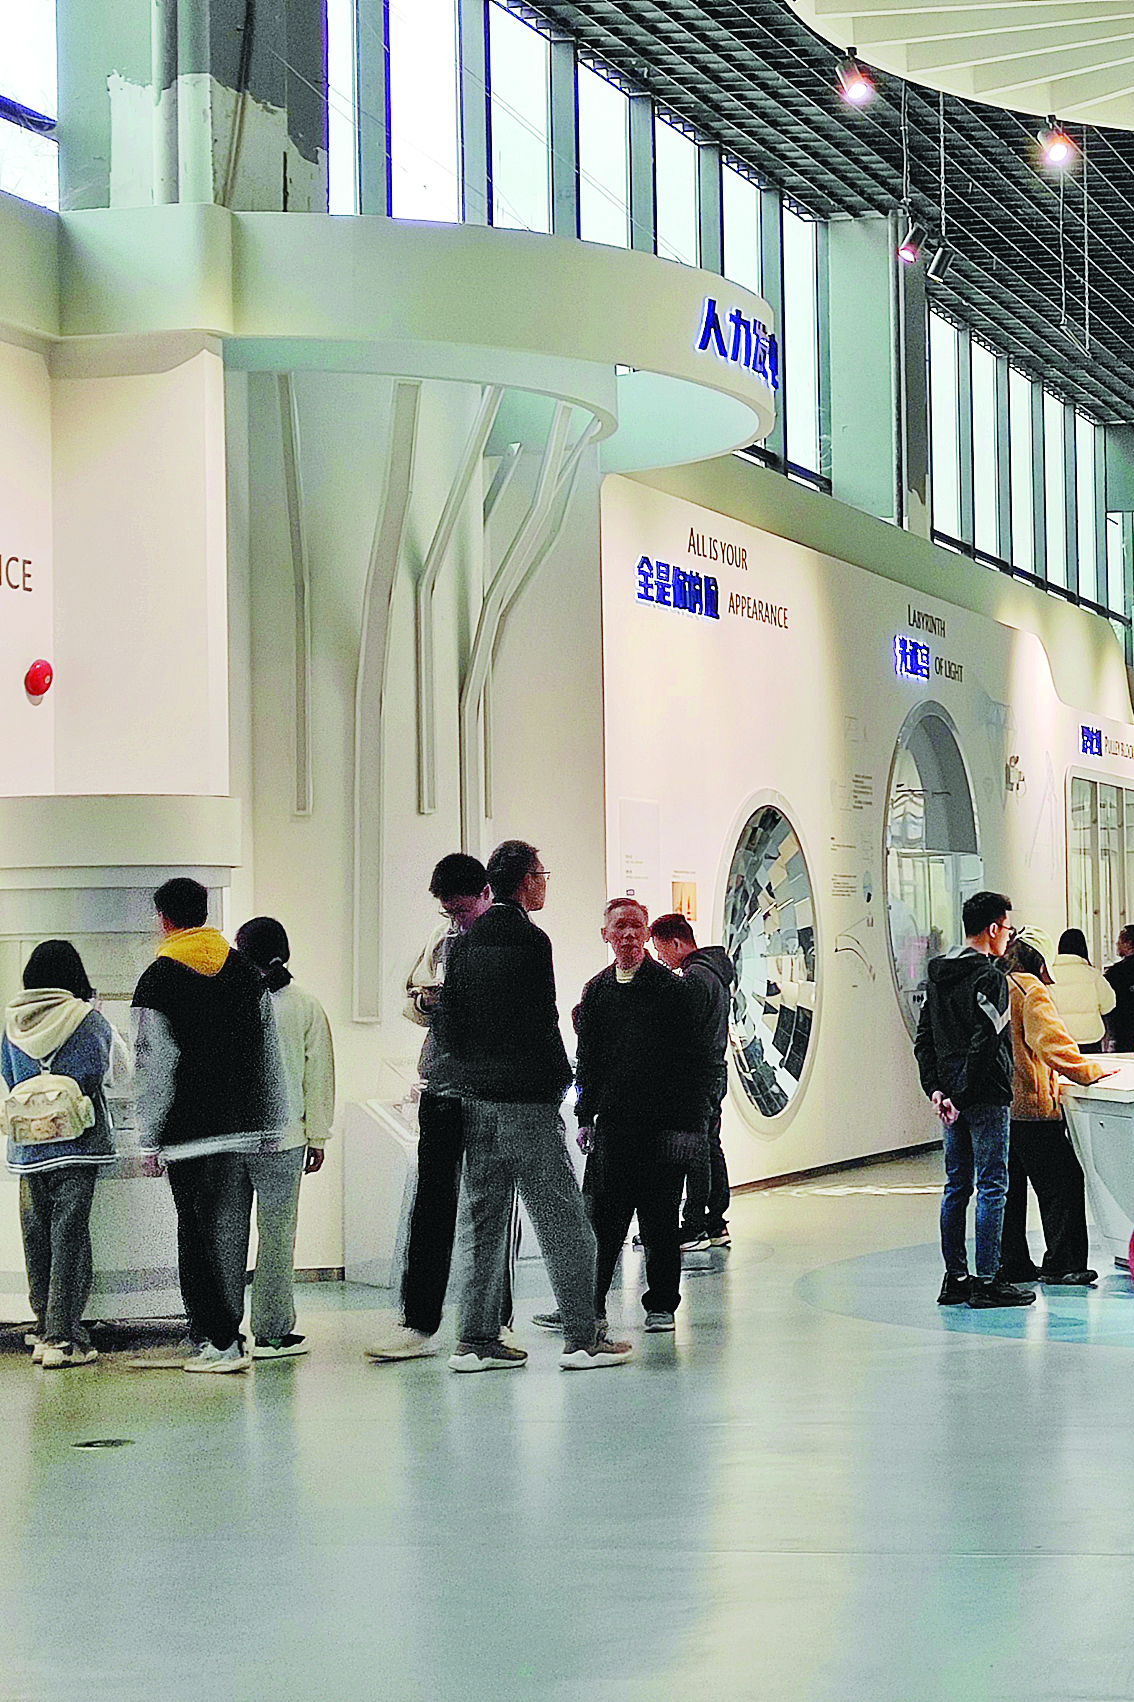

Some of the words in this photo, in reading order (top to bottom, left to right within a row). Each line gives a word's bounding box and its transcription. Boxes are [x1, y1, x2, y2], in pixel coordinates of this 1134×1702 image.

[687, 526, 708, 558] ALL
[708, 536, 718, 561] IS
[719, 541, 748, 571] YOUR
[728, 591, 789, 630] APPEARANCE
[934, 656, 944, 676] OF
